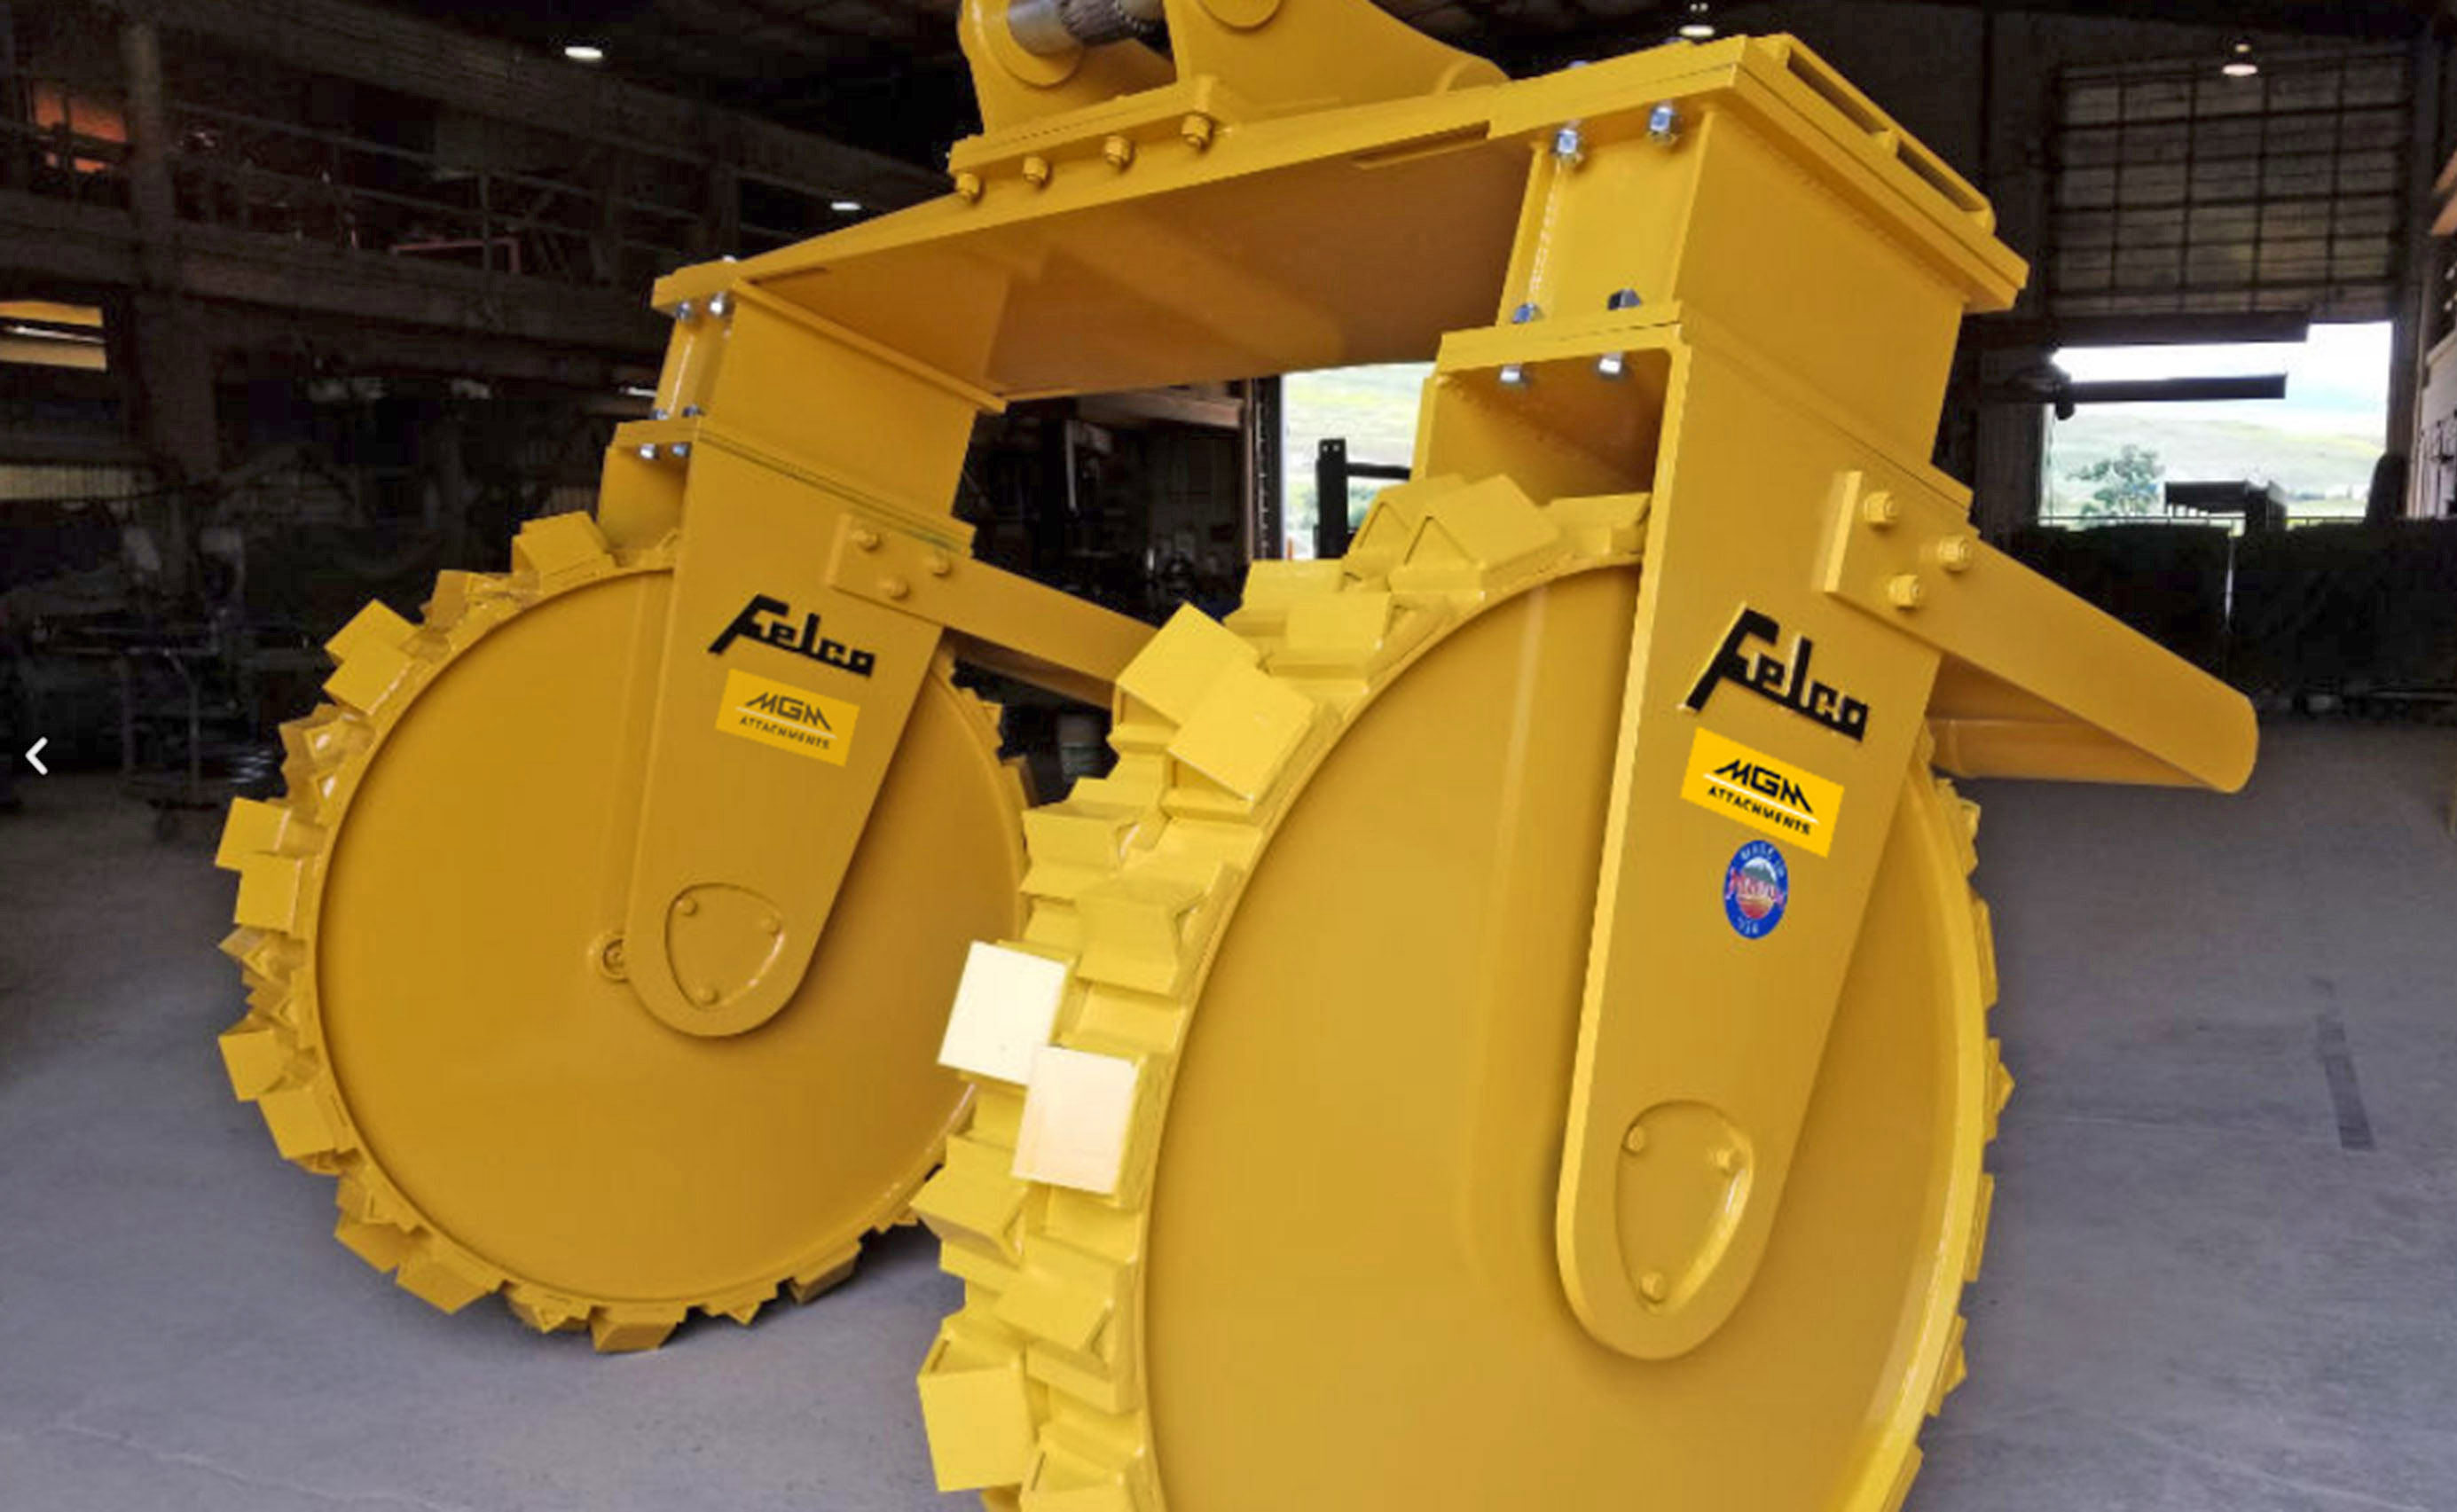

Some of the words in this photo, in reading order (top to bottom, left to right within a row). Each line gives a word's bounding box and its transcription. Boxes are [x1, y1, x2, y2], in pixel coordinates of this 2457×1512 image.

[708, 593, 875, 678] Felco
[1684, 607, 1869, 742] Felco
[740, 717, 829, 749] ATTACHMENTS
[746, 692, 832, 732] MGM
[1707, 786, 1810, 835] ATTACHMENTS
[1714, 759, 1813, 813] MGM
